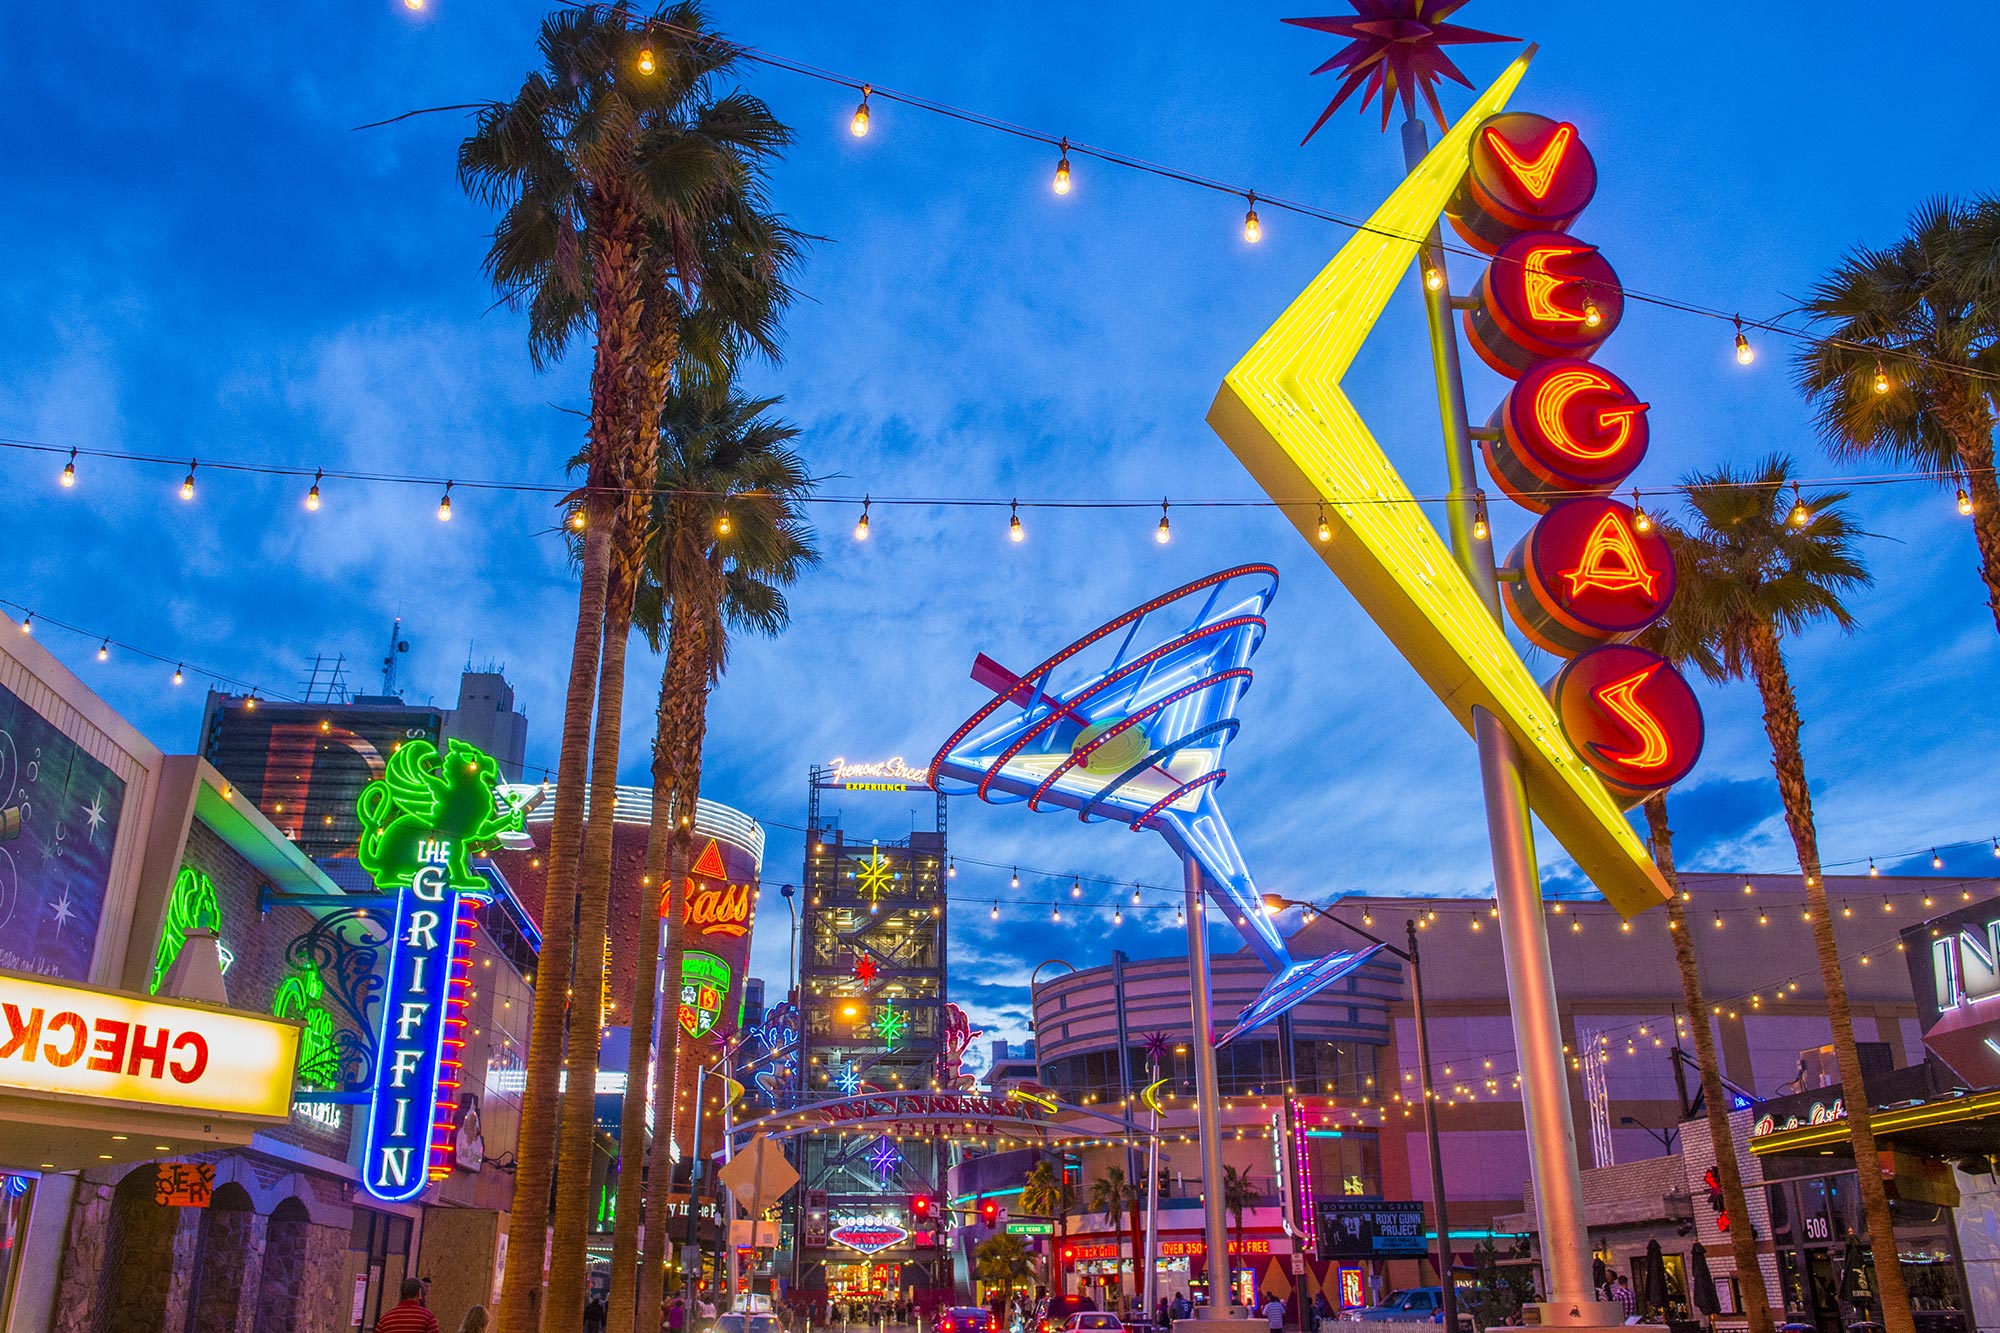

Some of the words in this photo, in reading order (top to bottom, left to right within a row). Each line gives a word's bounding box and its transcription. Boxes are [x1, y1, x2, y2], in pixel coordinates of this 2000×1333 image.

[1482, 120, 1672, 770] VEGAS
[828, 756, 884, 784] Fremont
[883, 756, 930, 784] Street
[845, 782, 907, 792] EXPERIENCE
[417, 841, 451, 863] THE
[659, 876, 750, 925] Bass
[374, 866, 447, 1188] GRIFFIN
[1323, 1203, 1382, 1211] DOWNTOWN
[838, 1217, 901, 1226] WELCOME
[1375, 1213, 1397, 1225] ROXY
[1398, 1213, 1421, 1225] GUNN
[1381, 1224, 1418, 1236] PROJECT
[1806, 1218, 1828, 1239] 508
[1099, 1244, 1118, 1257] Grill
[1163, 1242, 1184, 1255] OVER
[1185, 1242, 1203, 1254] 350
[1246, 1241, 1269, 1253] FREE
